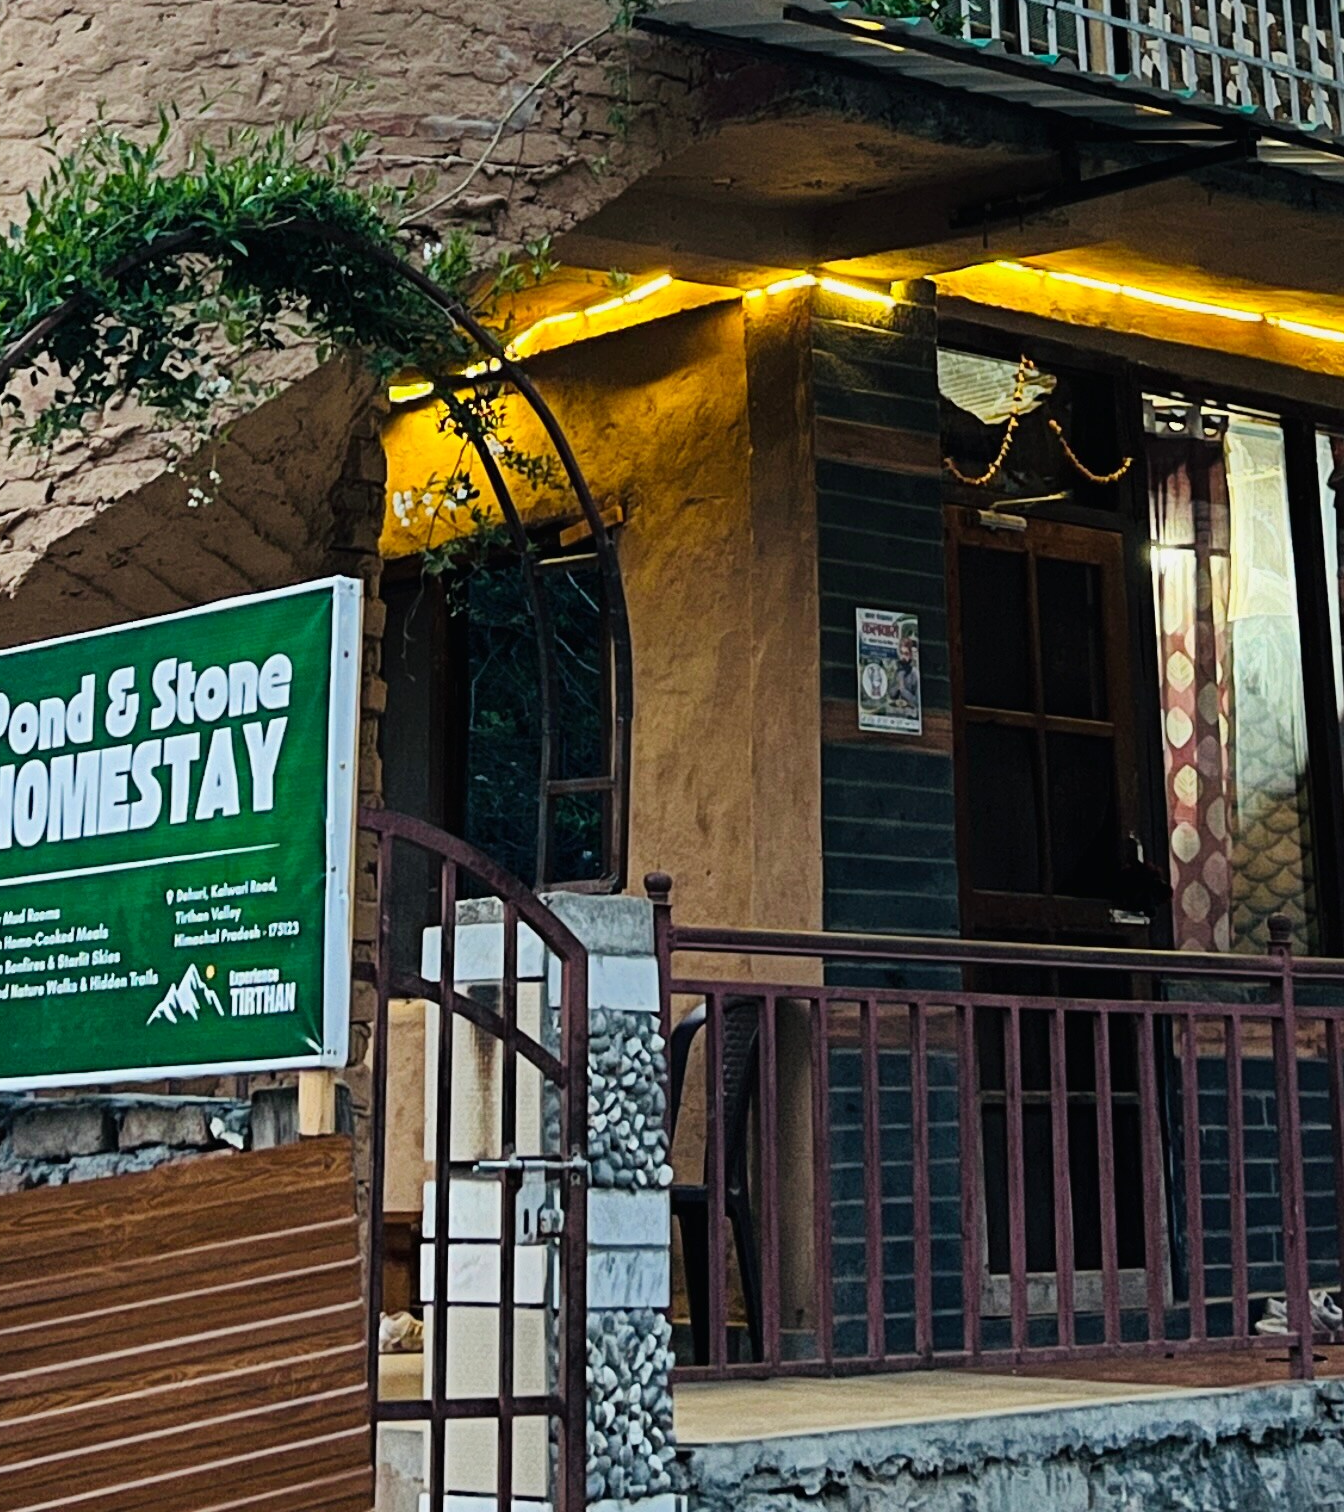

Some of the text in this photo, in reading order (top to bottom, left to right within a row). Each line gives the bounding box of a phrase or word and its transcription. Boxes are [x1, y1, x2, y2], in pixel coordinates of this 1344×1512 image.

[105, 666, 140, 738] &
[150, 653, 293, 731] Stone
[211, 880, 249, 898] Kalwari
[250, 876, 278, 893] Road,
[3, 908, 26, 925] Mud
[27, 908, 61, 922] Rooms
[175, 904, 242, 925] Tirthan Valley
[4, 926, 75, 949] Home-Cooked
[76, 923, 109, 942] Meals
[174, 928, 220, 948] Himachal
[221, 924, 261, 943] Pradesh
[5, 956, 46, 974] Bonfires
[47, 955, 55, 970] &
[57, 951, 89, 969] Starlit
[92, 949, 121, 966] Skies
[10, 983, 45, 999] Nature
[46, 978, 77, 995] Walks
[79, 976, 87, 992] &
[89, 972, 127, 990] Hidden
[129, 968, 159, 986] Trails
[229, 968, 280, 986] Experience
[230, 982, 296, 1016] TIRTHAN
